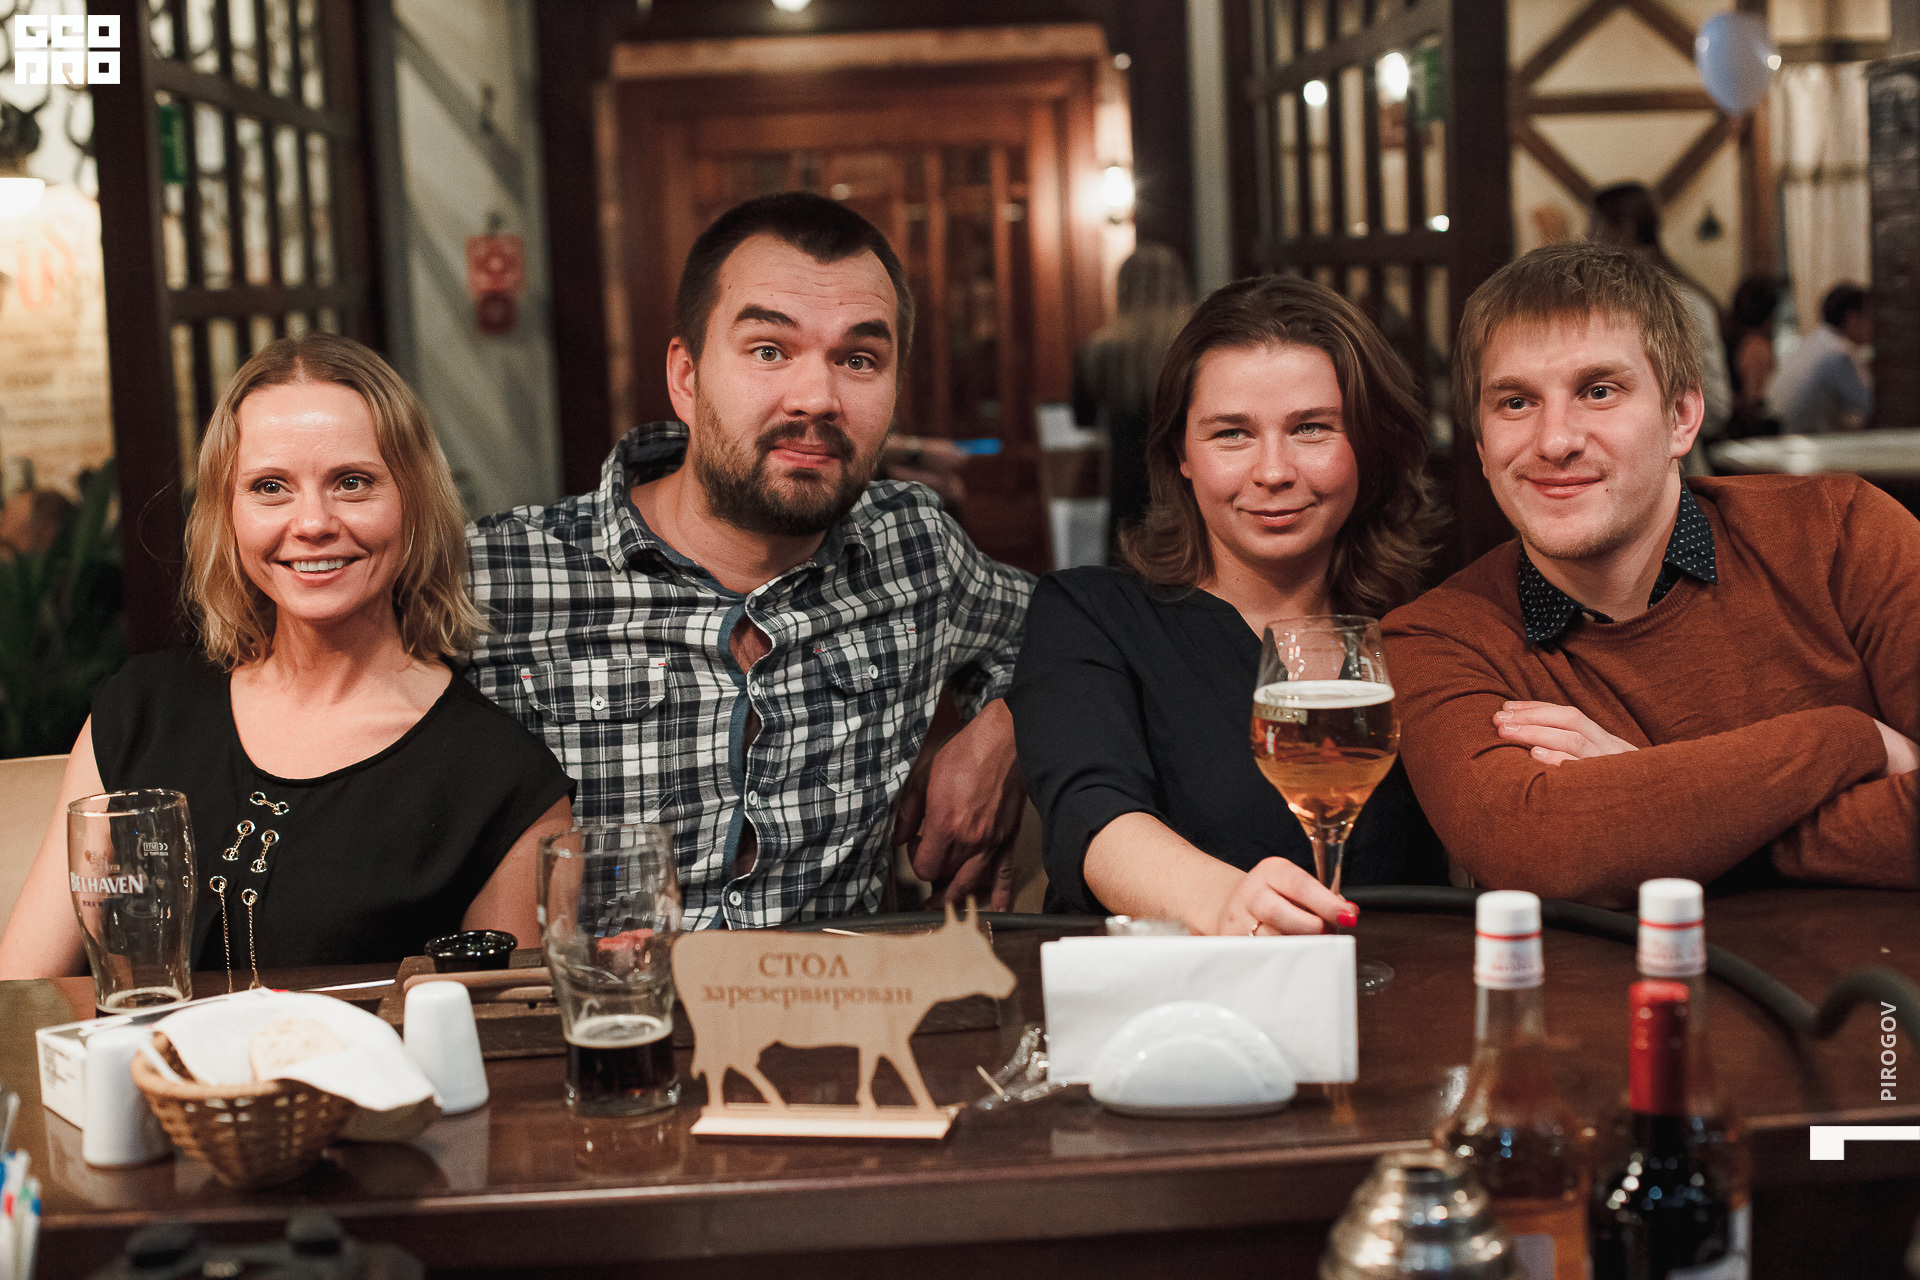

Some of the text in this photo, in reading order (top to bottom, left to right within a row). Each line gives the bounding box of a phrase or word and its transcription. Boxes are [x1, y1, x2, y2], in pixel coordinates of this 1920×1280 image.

[70, 871, 144, 894] BELHAVEN
[757, 952, 850, 980] СТОЛ
[702, 984, 913, 1011] зарезервирован
